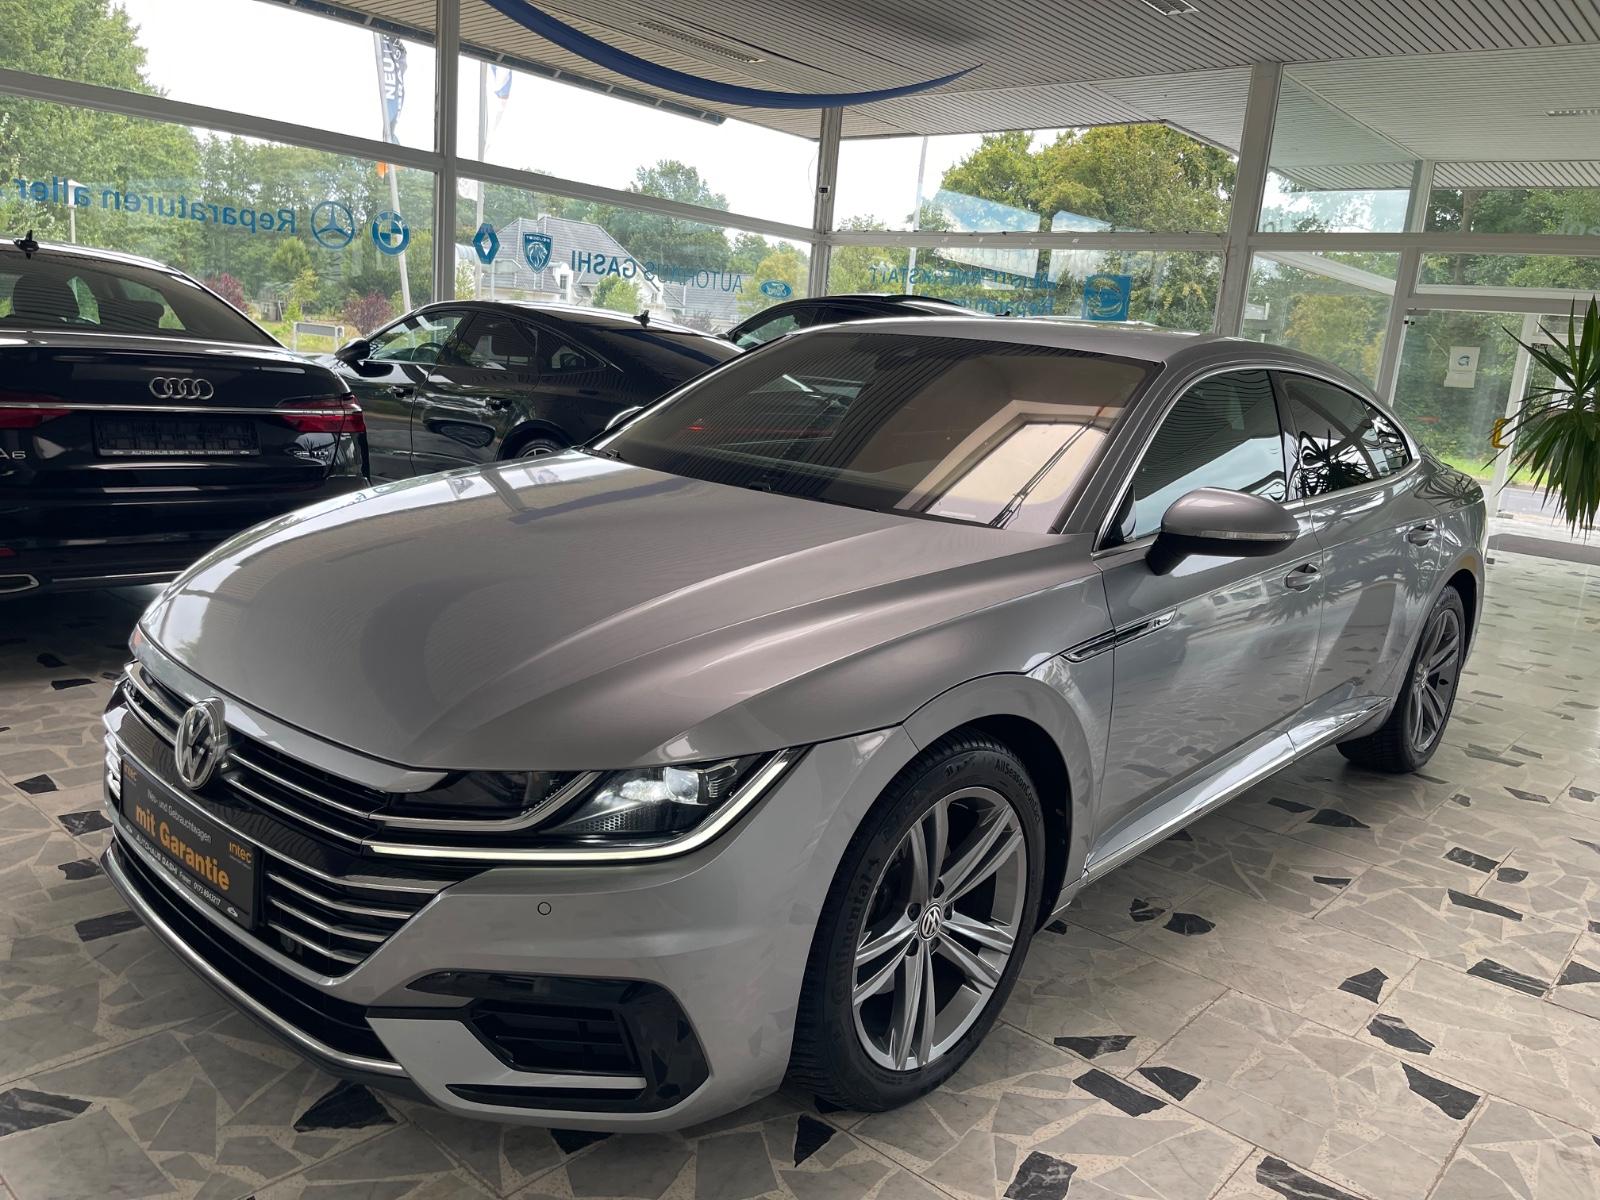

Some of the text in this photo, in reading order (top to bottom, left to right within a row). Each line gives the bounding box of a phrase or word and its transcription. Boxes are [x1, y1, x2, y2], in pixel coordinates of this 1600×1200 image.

[135, 802, 230, 890] mit Garantie
[168, 805, 212, 844] Gebrauchtwagen
